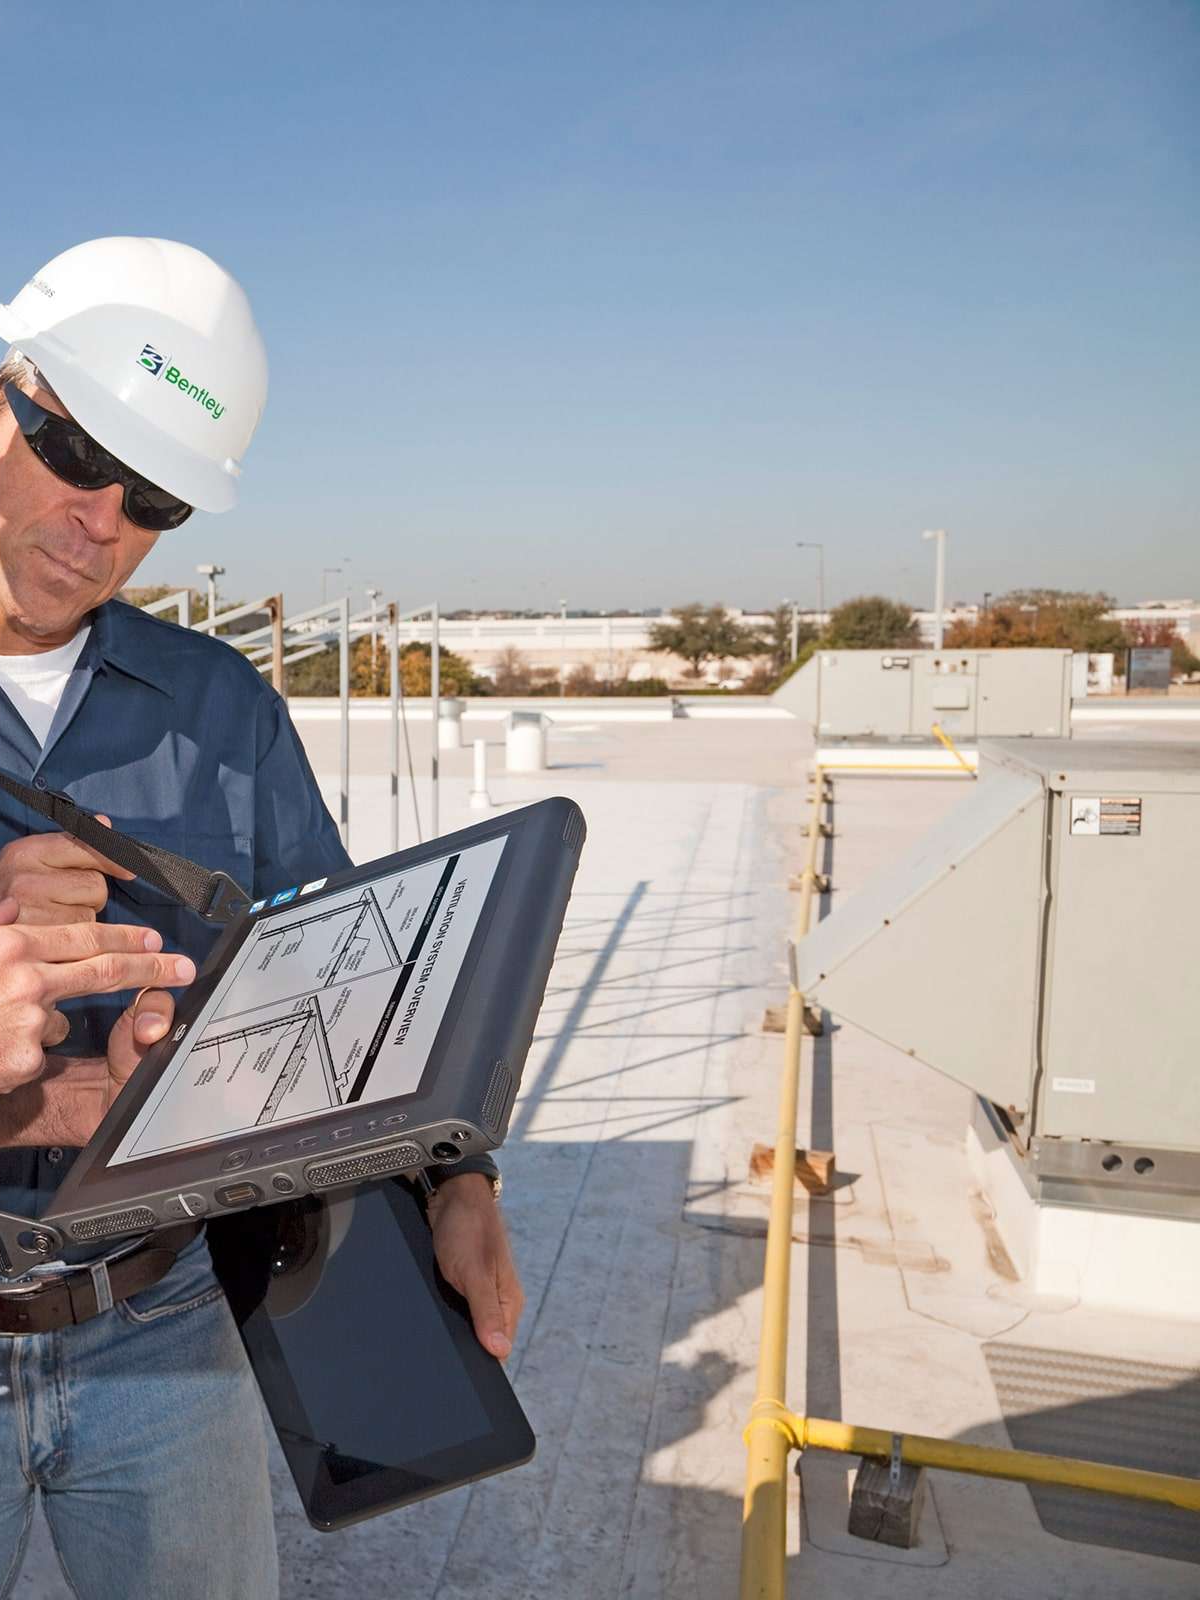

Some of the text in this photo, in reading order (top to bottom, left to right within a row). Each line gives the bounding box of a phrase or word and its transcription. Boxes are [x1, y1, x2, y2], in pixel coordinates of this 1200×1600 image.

[165, 366, 225, 420] Bentley
[393, 879, 468, 1045] VENTILATION SYSTEM OVERVIEW
